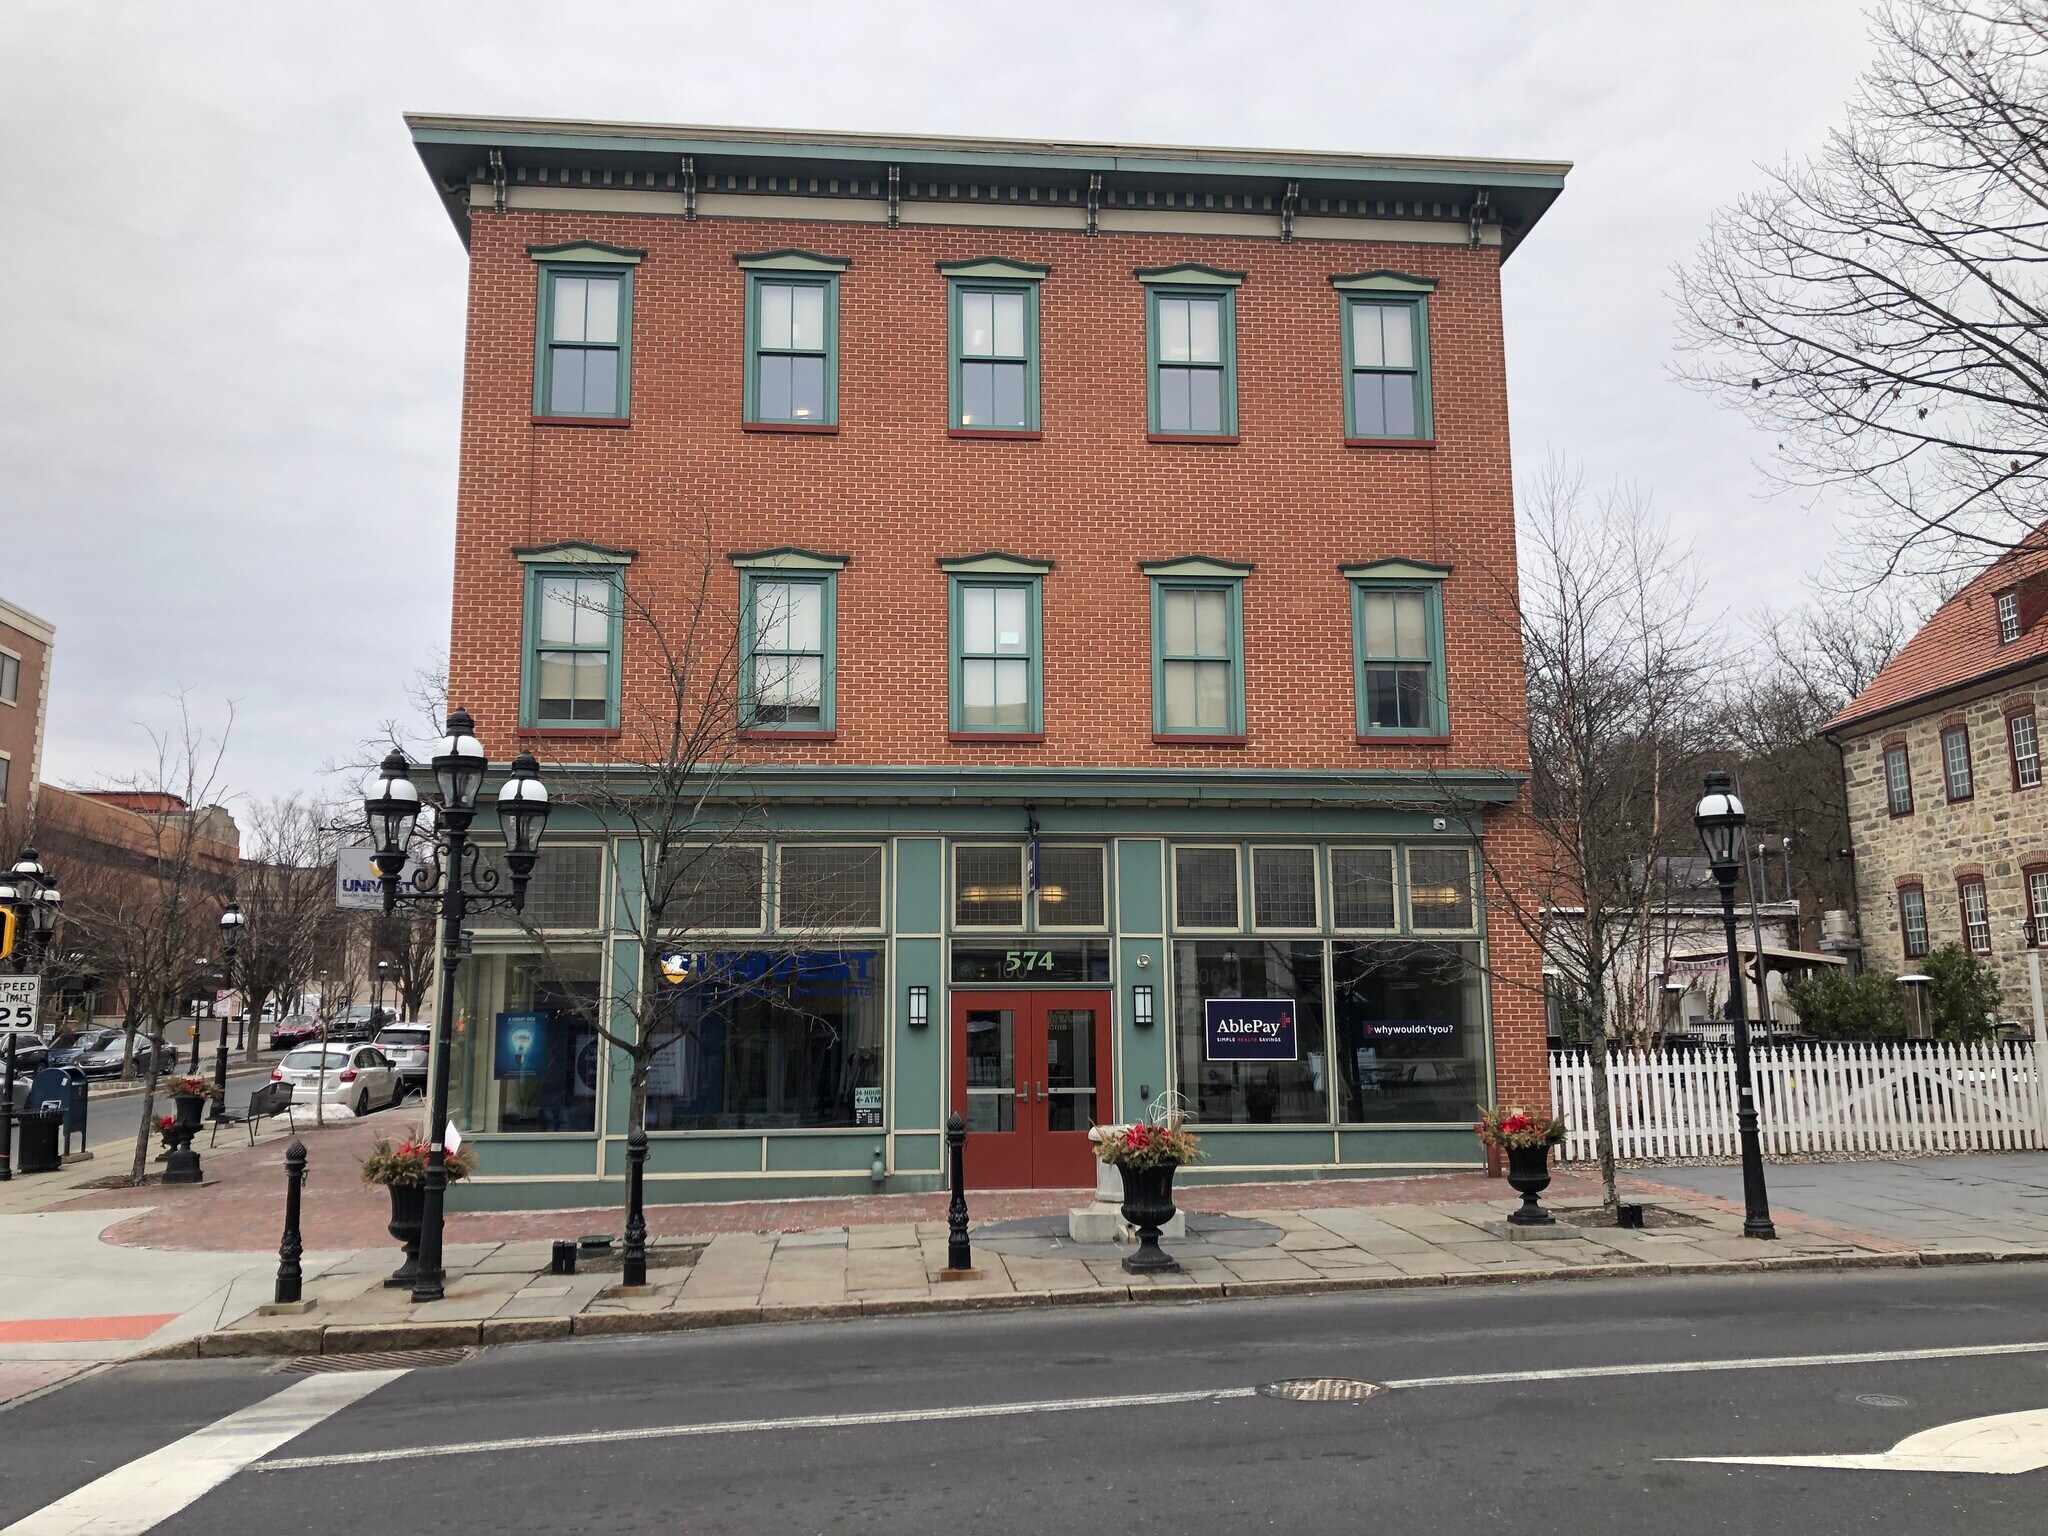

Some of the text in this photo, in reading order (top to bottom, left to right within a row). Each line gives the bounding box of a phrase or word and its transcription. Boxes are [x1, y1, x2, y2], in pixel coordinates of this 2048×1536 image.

[342, 879, 415, 893] UNIVST
[1006, 951, 1055, 971] 574
[0, 982, 36, 991] PEED
[0, 1007, 32, 1028] 25
[1216, 1019, 1280, 1037] AblePay
